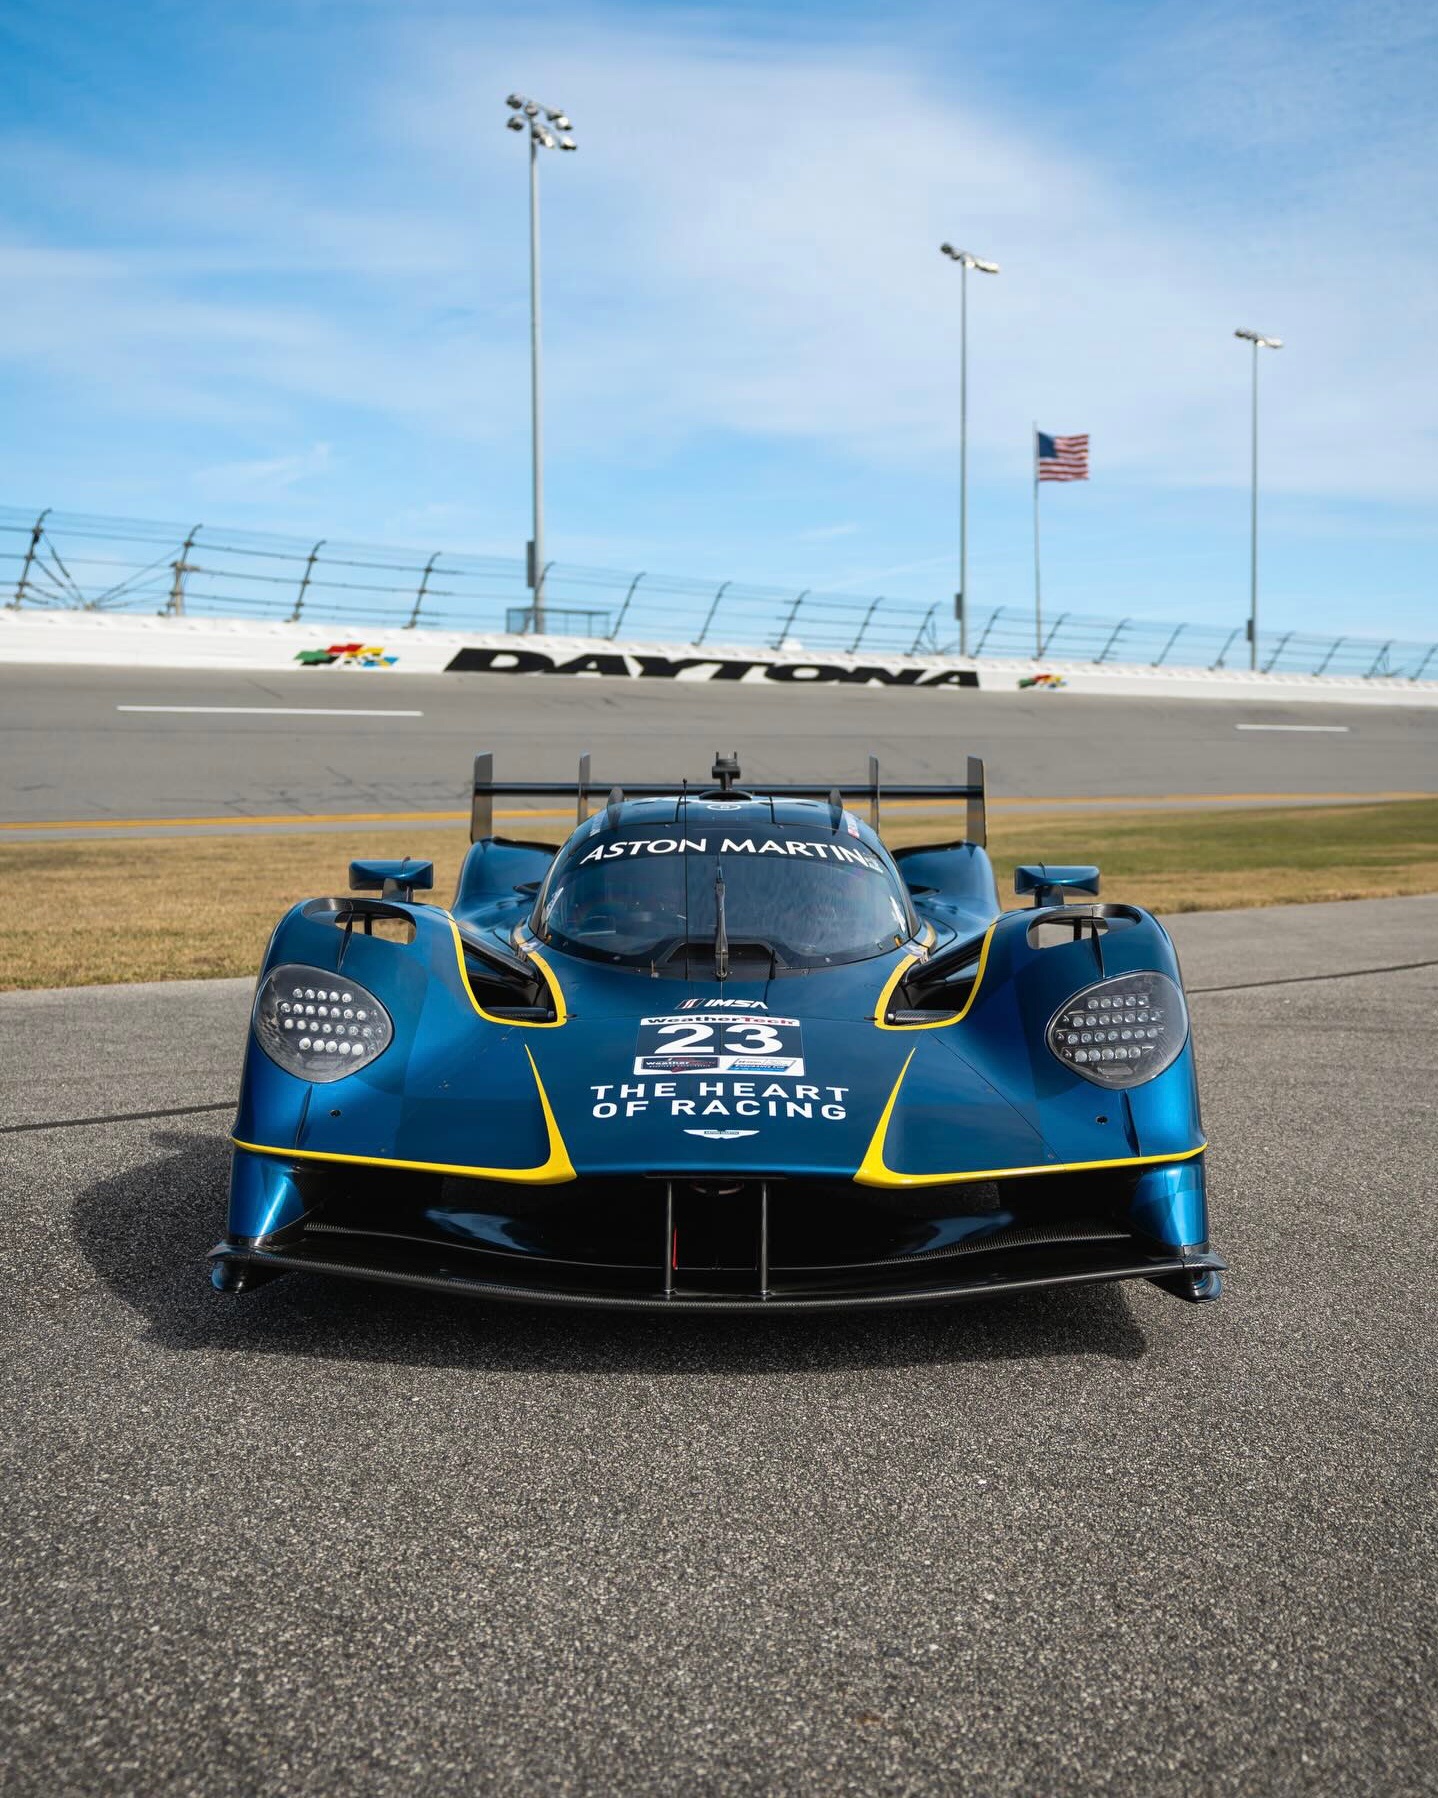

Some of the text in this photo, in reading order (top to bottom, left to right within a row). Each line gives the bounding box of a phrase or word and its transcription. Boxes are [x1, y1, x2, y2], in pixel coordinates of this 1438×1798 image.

[443, 647, 980, 688] DAYTONA
[580, 839, 706, 865] ASTON
[720, 838, 870, 868] MARTIN
[704, 999, 768, 1009] IMSA
[654, 1023, 783, 1054] 23
[590, 1082, 849, 1102] THE HEART
[592, 1100, 847, 1120] OF RACING
